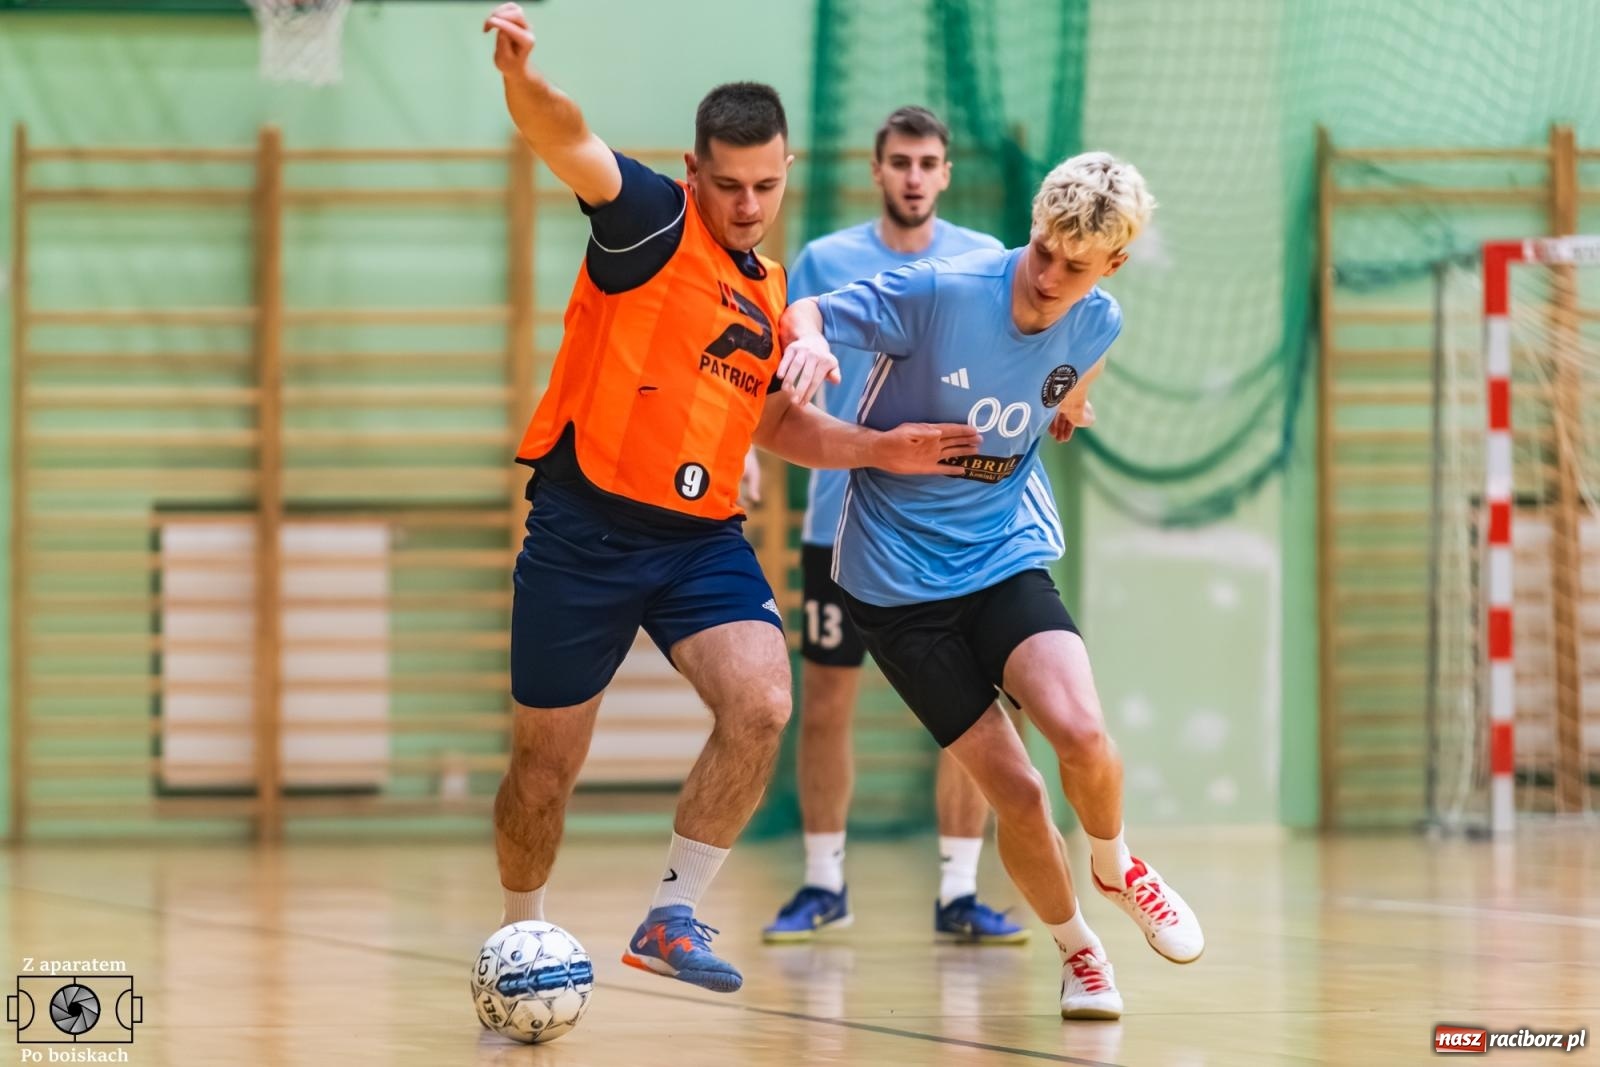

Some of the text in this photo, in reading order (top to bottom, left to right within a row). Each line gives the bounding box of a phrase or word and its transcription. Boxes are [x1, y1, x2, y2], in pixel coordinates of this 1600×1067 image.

[699, 355, 763, 397] PATRICK
[967, 397, 1032, 438] 00
[681, 465, 704, 498] 9
[946, 457, 1017, 473] ABRIL
[805, 599, 842, 648] 13
